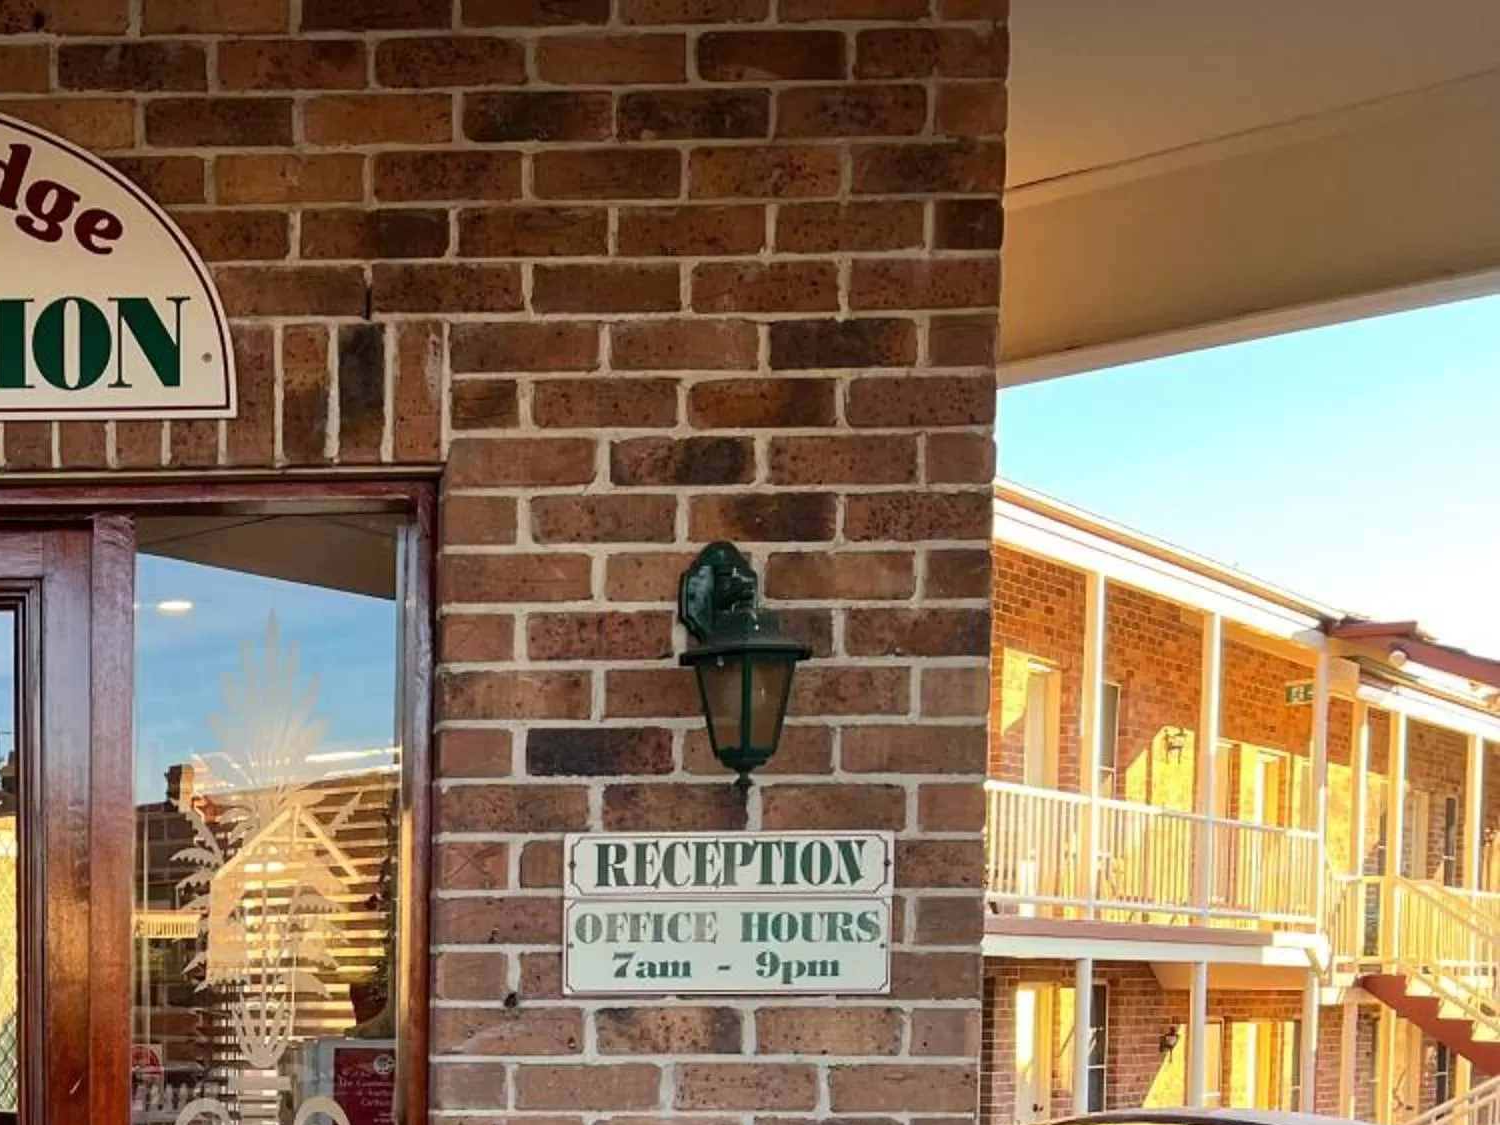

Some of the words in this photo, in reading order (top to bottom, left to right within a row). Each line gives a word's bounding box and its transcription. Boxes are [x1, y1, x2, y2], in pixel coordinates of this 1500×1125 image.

[595, 840, 867, 888] RECEPTION
[575, 912, 717, 944] OFFICE
[740, 911, 881, 943] HOURS
[611, 951, 692, 979] 7am
[755, 951, 839, 984] 9pm
